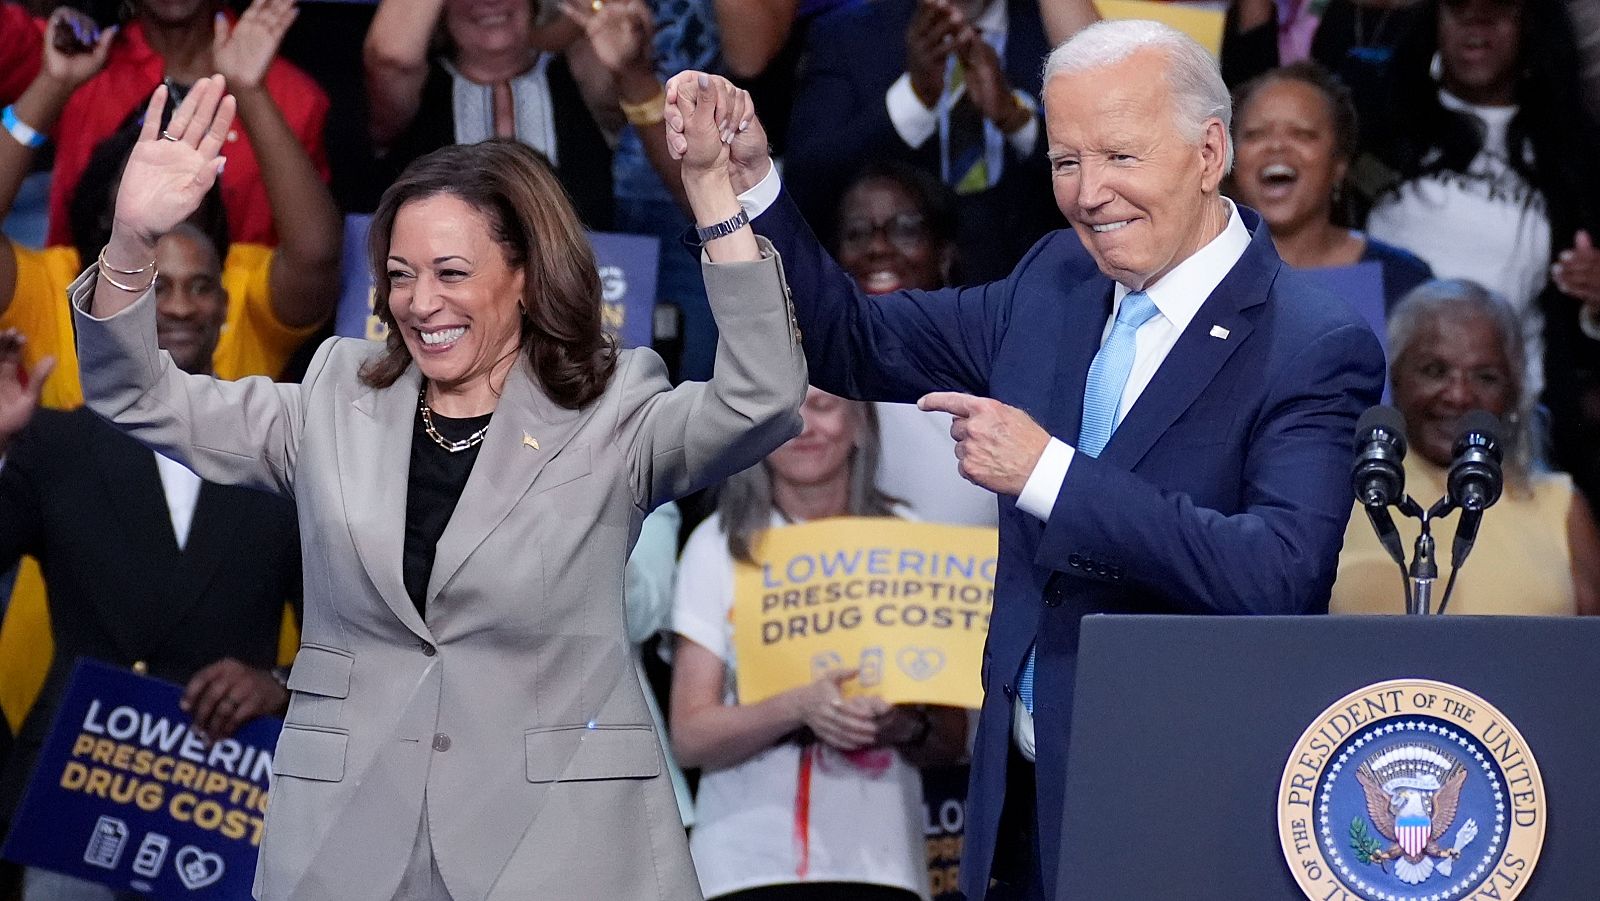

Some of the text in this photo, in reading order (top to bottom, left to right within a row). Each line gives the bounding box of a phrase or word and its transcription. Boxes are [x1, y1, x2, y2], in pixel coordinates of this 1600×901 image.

[762, 606, 862, 646] DRUG
[1413, 693, 1438, 709] OF
[1443, 698, 1475, 723] THE
[83, 699, 273, 782] LOWERIN
[1288, 690, 1404, 808] PRESIDENT
[72, 733, 269, 812] PRESCRIPTI
[1482, 721, 1536, 827] UNITED
[60, 761, 264, 846] DRUG COST
[1291, 818, 1310, 854] THE
[1302, 859, 1322, 880] OF
[1470, 852, 1525, 901] STA
